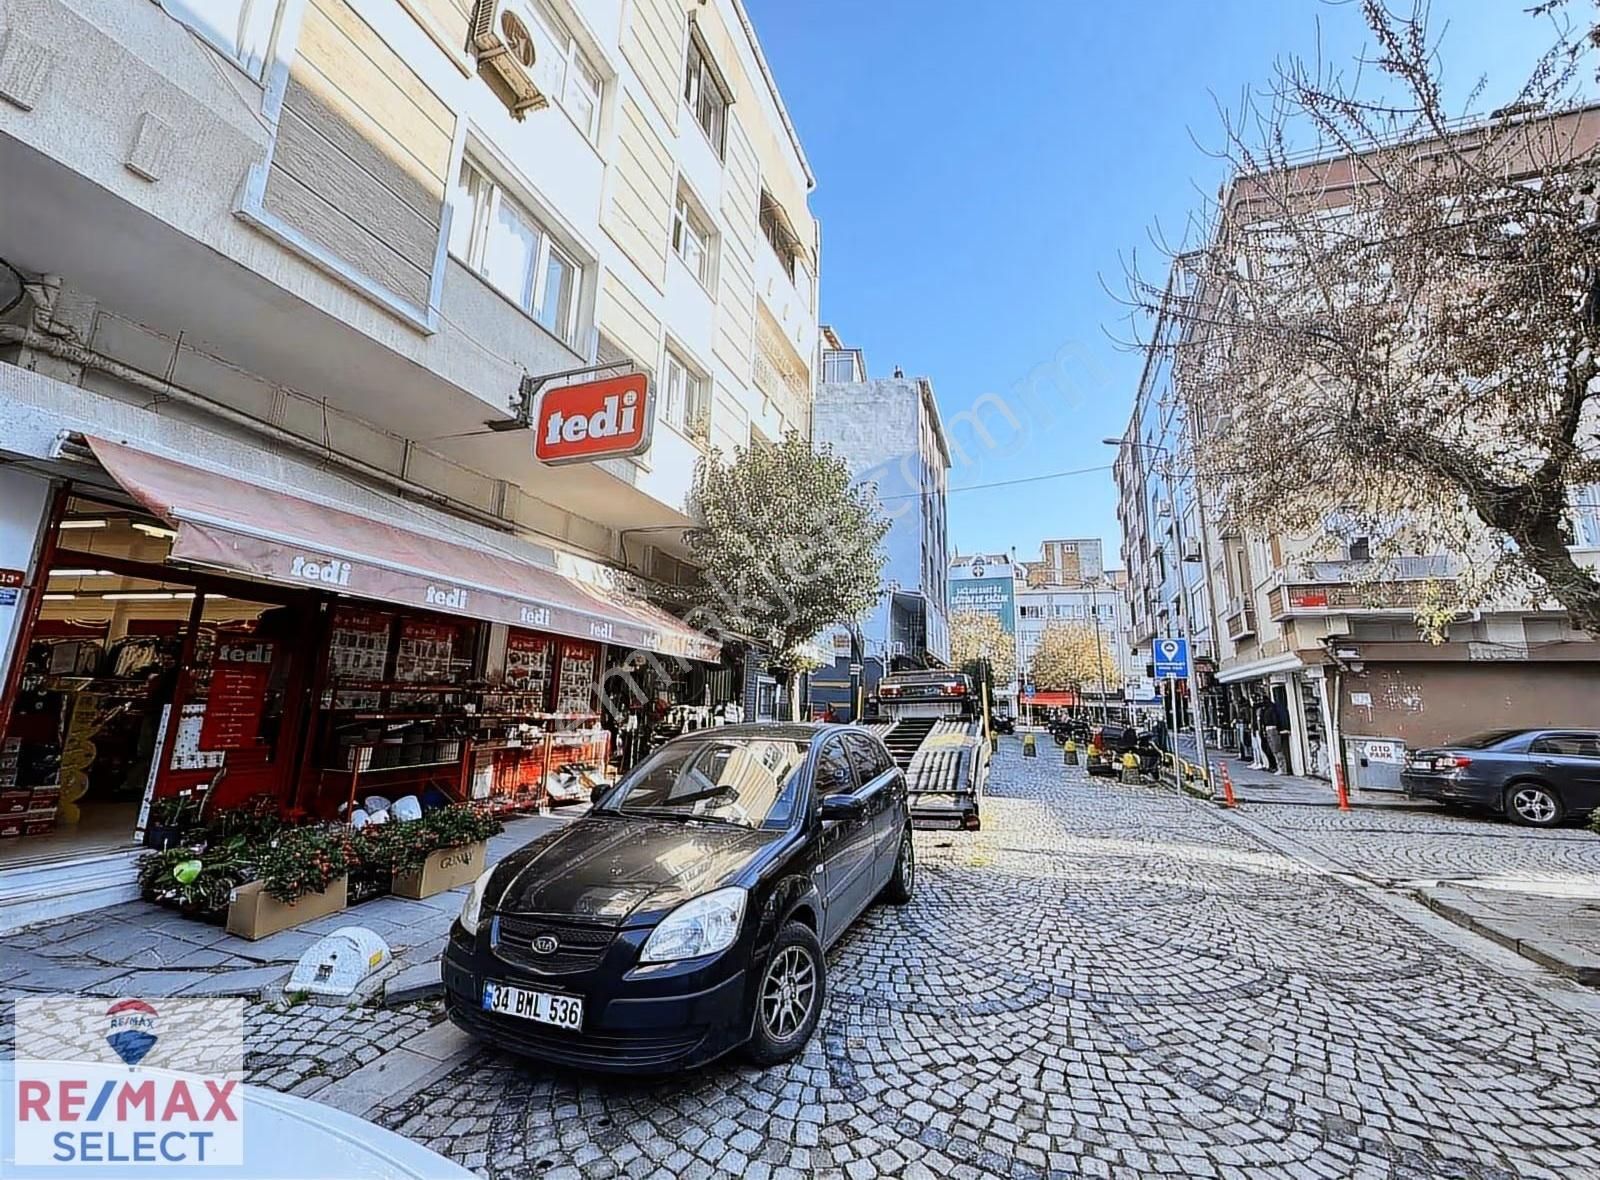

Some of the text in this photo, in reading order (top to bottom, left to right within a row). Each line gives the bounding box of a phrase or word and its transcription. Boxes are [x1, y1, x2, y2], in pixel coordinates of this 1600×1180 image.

[545, 390, 638, 445] tedi
[291, 556, 351, 586] tedi
[425, 585, 468, 610] tedi
[520, 607, 552, 626] tedi
[589, 621, 614, 639] tedi
[219, 644, 274, 664] tedi
[492, 987, 510, 1011] 34
[515, 991, 541, 1018] BML
[550, 998, 579, 1024] 536
